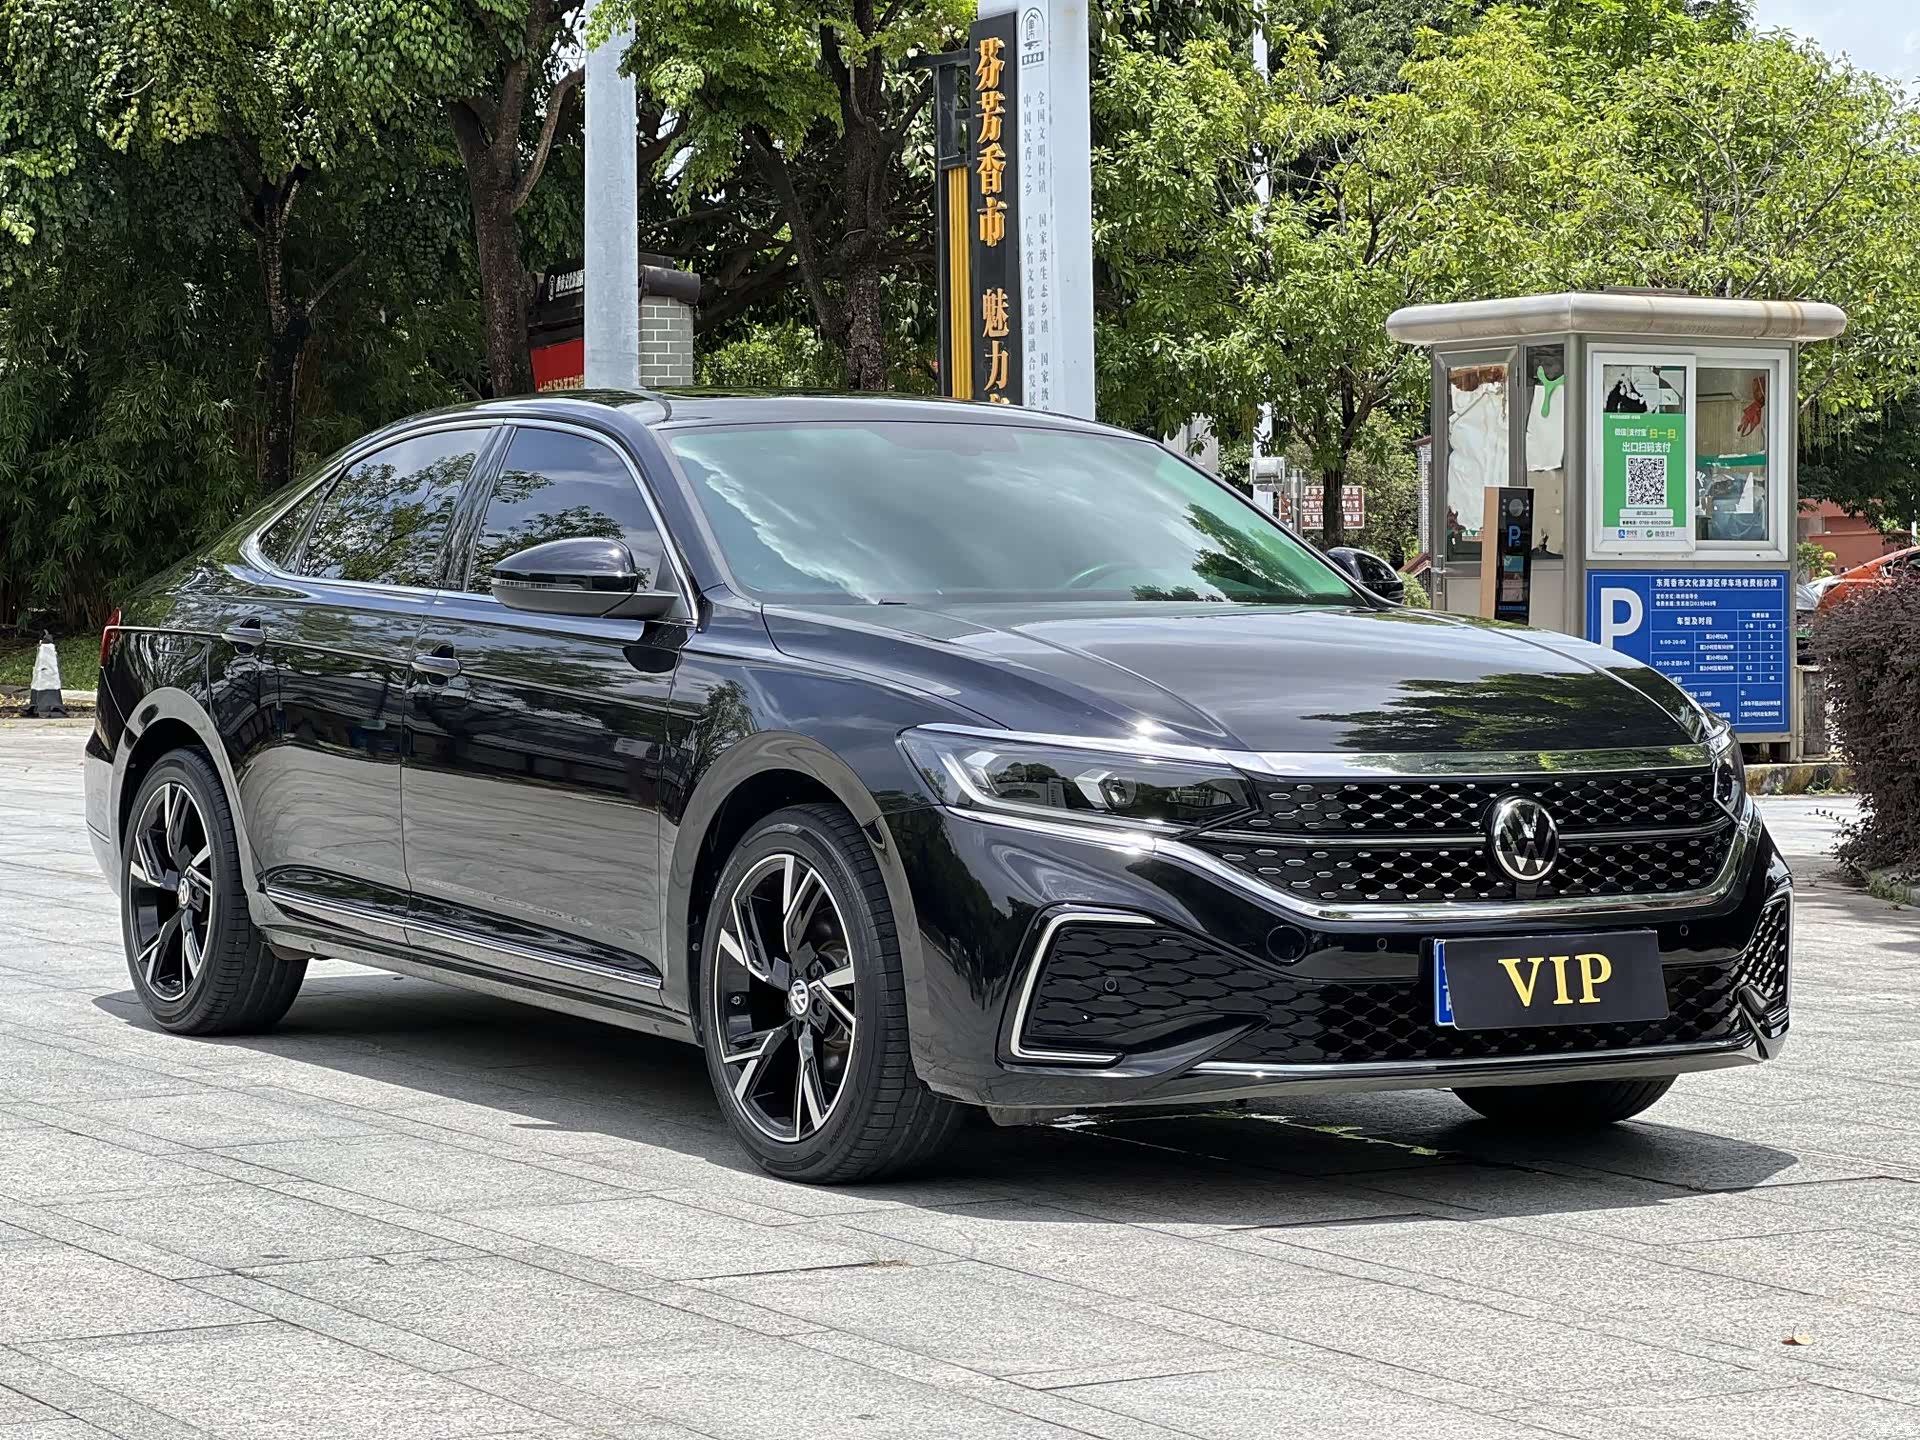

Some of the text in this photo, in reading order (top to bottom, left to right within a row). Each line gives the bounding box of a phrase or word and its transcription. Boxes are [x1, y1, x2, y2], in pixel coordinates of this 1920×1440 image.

[975, 37, 1010, 405] 芬芳香市 魅力
[1622, 441, 1671, 453] 出口扫码支付
[1655, 578, 1778, 588] 东莞香市文化旅游区停车场收费标价牌
[1600, 587, 1643, 650] P
[1676, 616, 1713, 626] 车型及时段
[1498, 953, 1613, 1008] VIP
